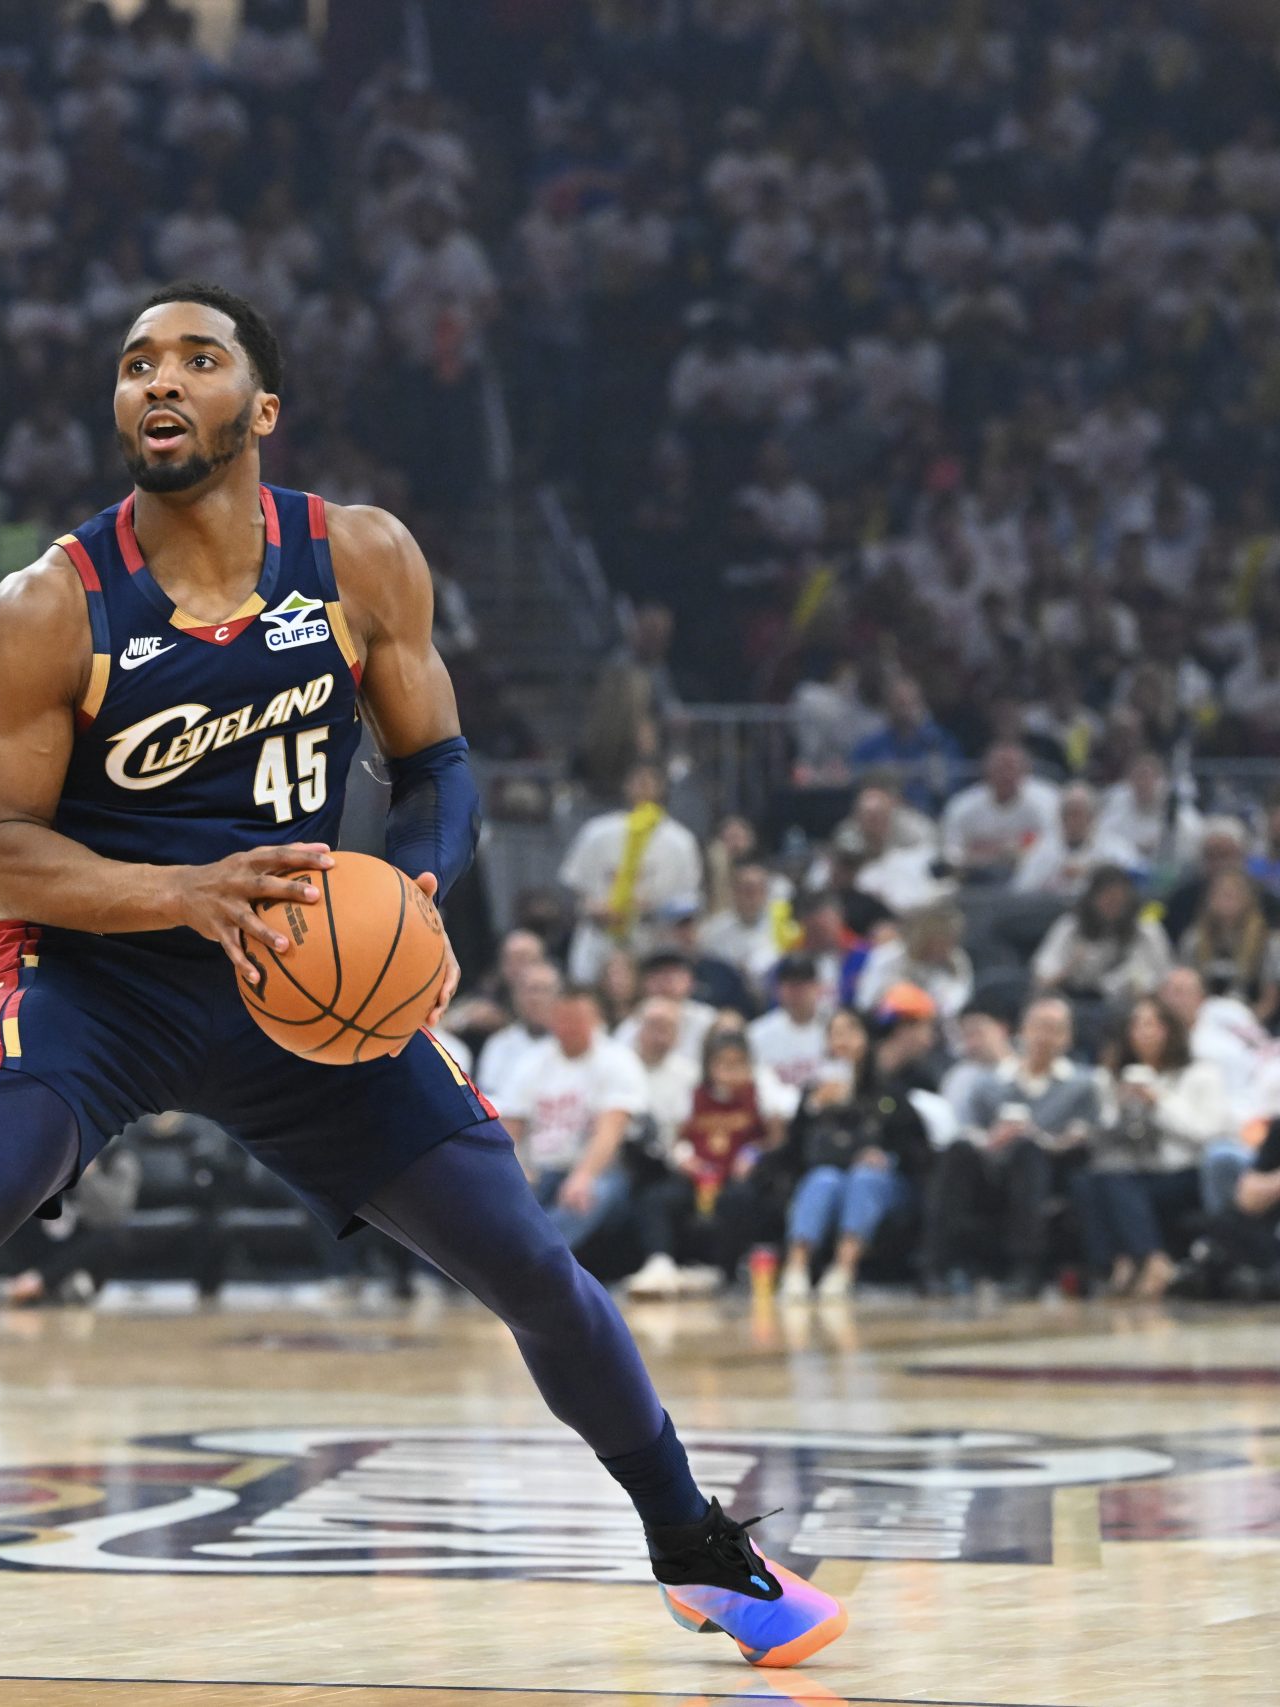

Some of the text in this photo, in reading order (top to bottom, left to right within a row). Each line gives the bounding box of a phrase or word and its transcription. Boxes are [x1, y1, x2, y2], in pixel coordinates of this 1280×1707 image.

[214, 626, 230, 641] C
[269, 623, 328, 646] CLIFFS
[127, 636, 163, 657] NIKE
[105, 673, 335, 791] CLEVELAND
[253, 725, 330, 824] 45
